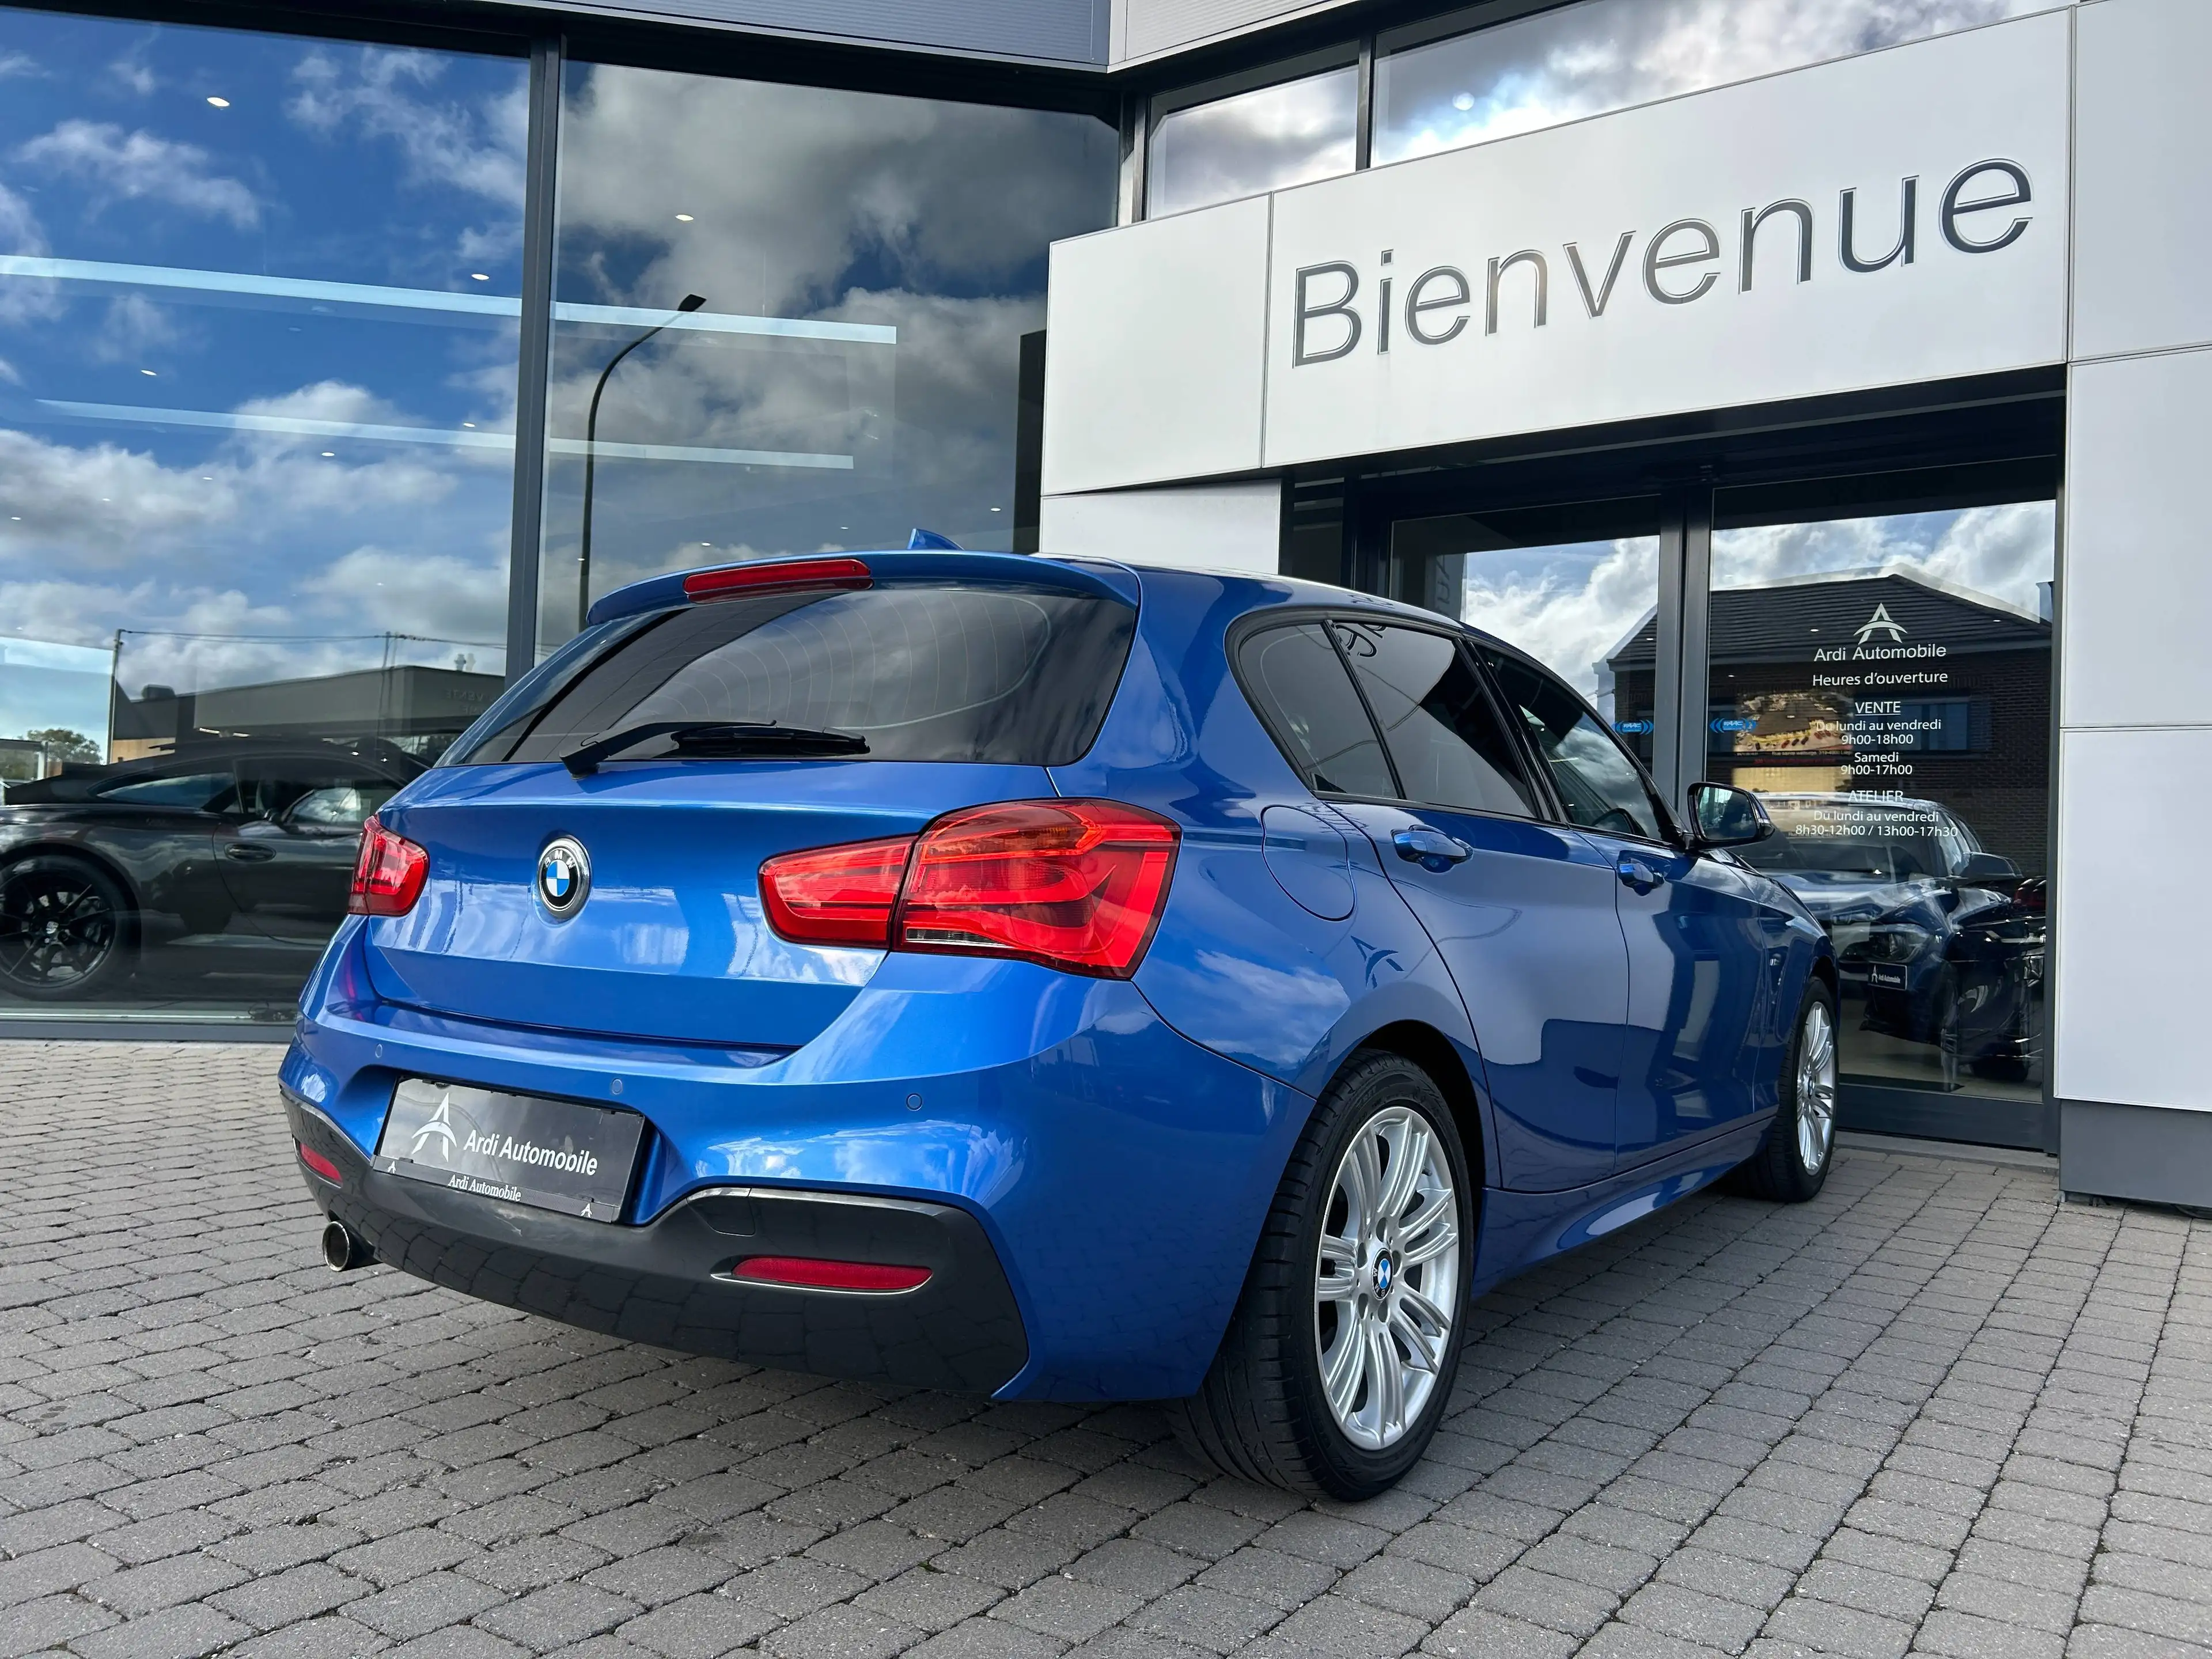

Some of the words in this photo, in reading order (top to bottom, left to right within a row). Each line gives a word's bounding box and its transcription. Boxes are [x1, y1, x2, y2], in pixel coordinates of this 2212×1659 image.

[1292, 158, 2033, 369] Bienvenue
[1813, 647, 1846, 661] Ardi
[1852, 643, 1947, 660] Automobile
[1812, 675, 1861, 686] Heures
[1864, 672, 1948, 684] d'ouverture
[1854, 701, 1901, 714] VENTE
[1816, 721, 1832, 731] Du
[1836, 720, 1866, 730] lundi
[1869, 722, 1884, 730] au
[1887, 719, 1941, 730] vendredi
[1841, 734, 1914, 745] 9h00-18h00
[1854, 752, 1899, 763] Samedi
[1840, 764, 1912, 775] 9h00-17h00
[1848, 790, 1904, 802] ATELIER
[1814, 810, 1830, 821] Du
[1834, 810, 1863, 821] lundi
[1867, 812, 1881, 821] au
[1884, 811, 1939, 822] vendredi
[1795, 825, 1865, 836] 8h30-12h00
[1867, 825, 1874, 836] /
[1877, 825, 1959, 837] 13h00-17h30
[544, 850, 576, 869] BMW
[463, 1130, 500, 1156] Ardi
[499, 1132, 599, 1176] Automobile
[448, 1174, 469, 1190] Ardi
[469, 1179, 522, 1202] Automobile
[1373, 1267, 1385, 1297] BMW
